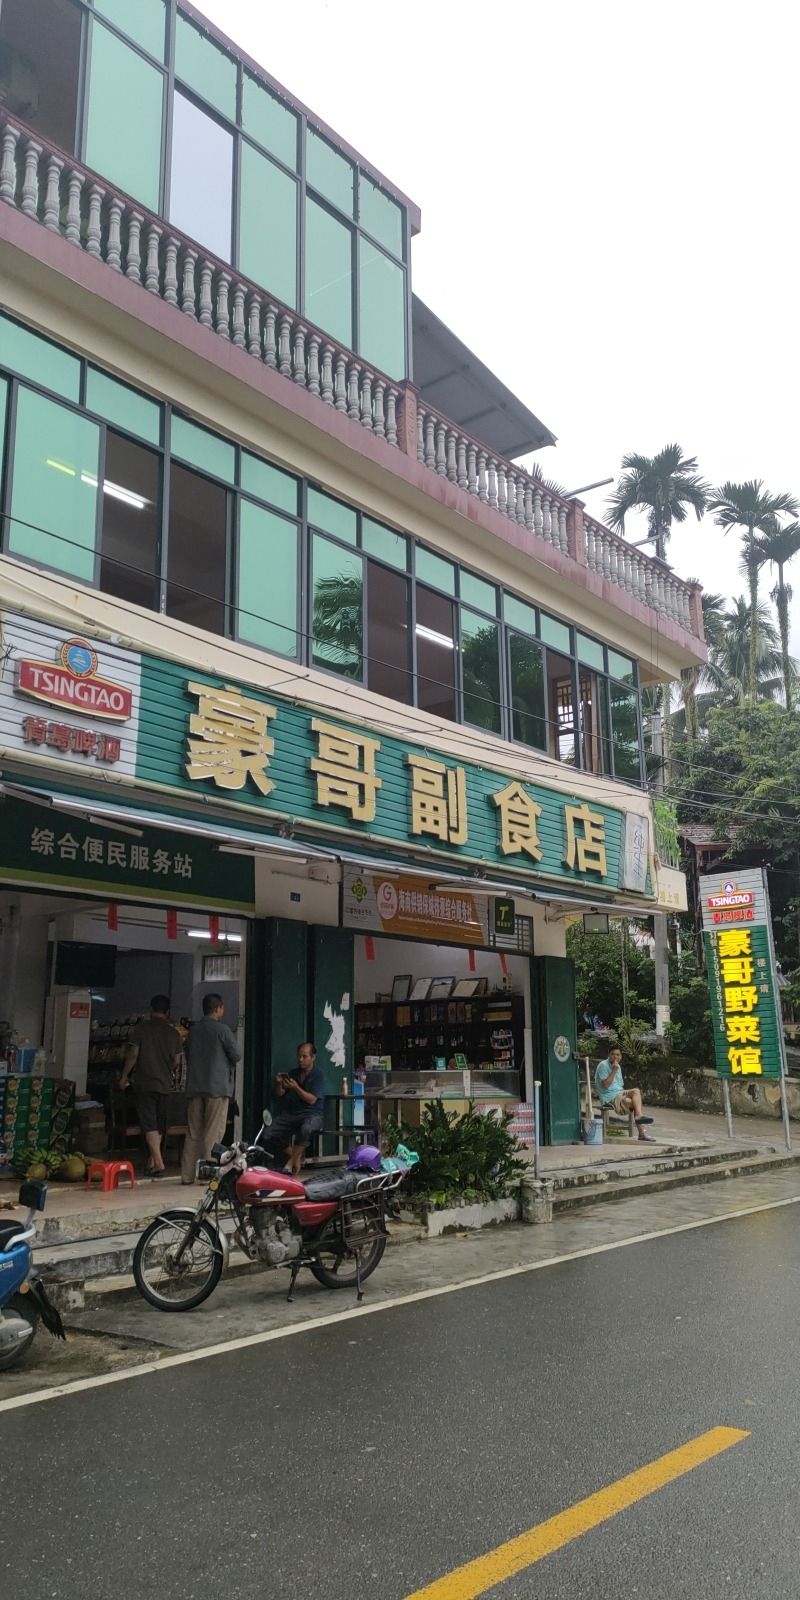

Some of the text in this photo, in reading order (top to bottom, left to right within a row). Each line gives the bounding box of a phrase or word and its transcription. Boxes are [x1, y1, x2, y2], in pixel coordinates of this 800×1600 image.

[29, 667, 125, 712] TSINGTAO
[185, 681, 607, 877] 豪哥副食店
[31, 827, 193, 879] 综合便民服务站
[710, 894, 750, 907] TSINGTAO
[717, 929, 763, 1075] 豪哥野菜馆
